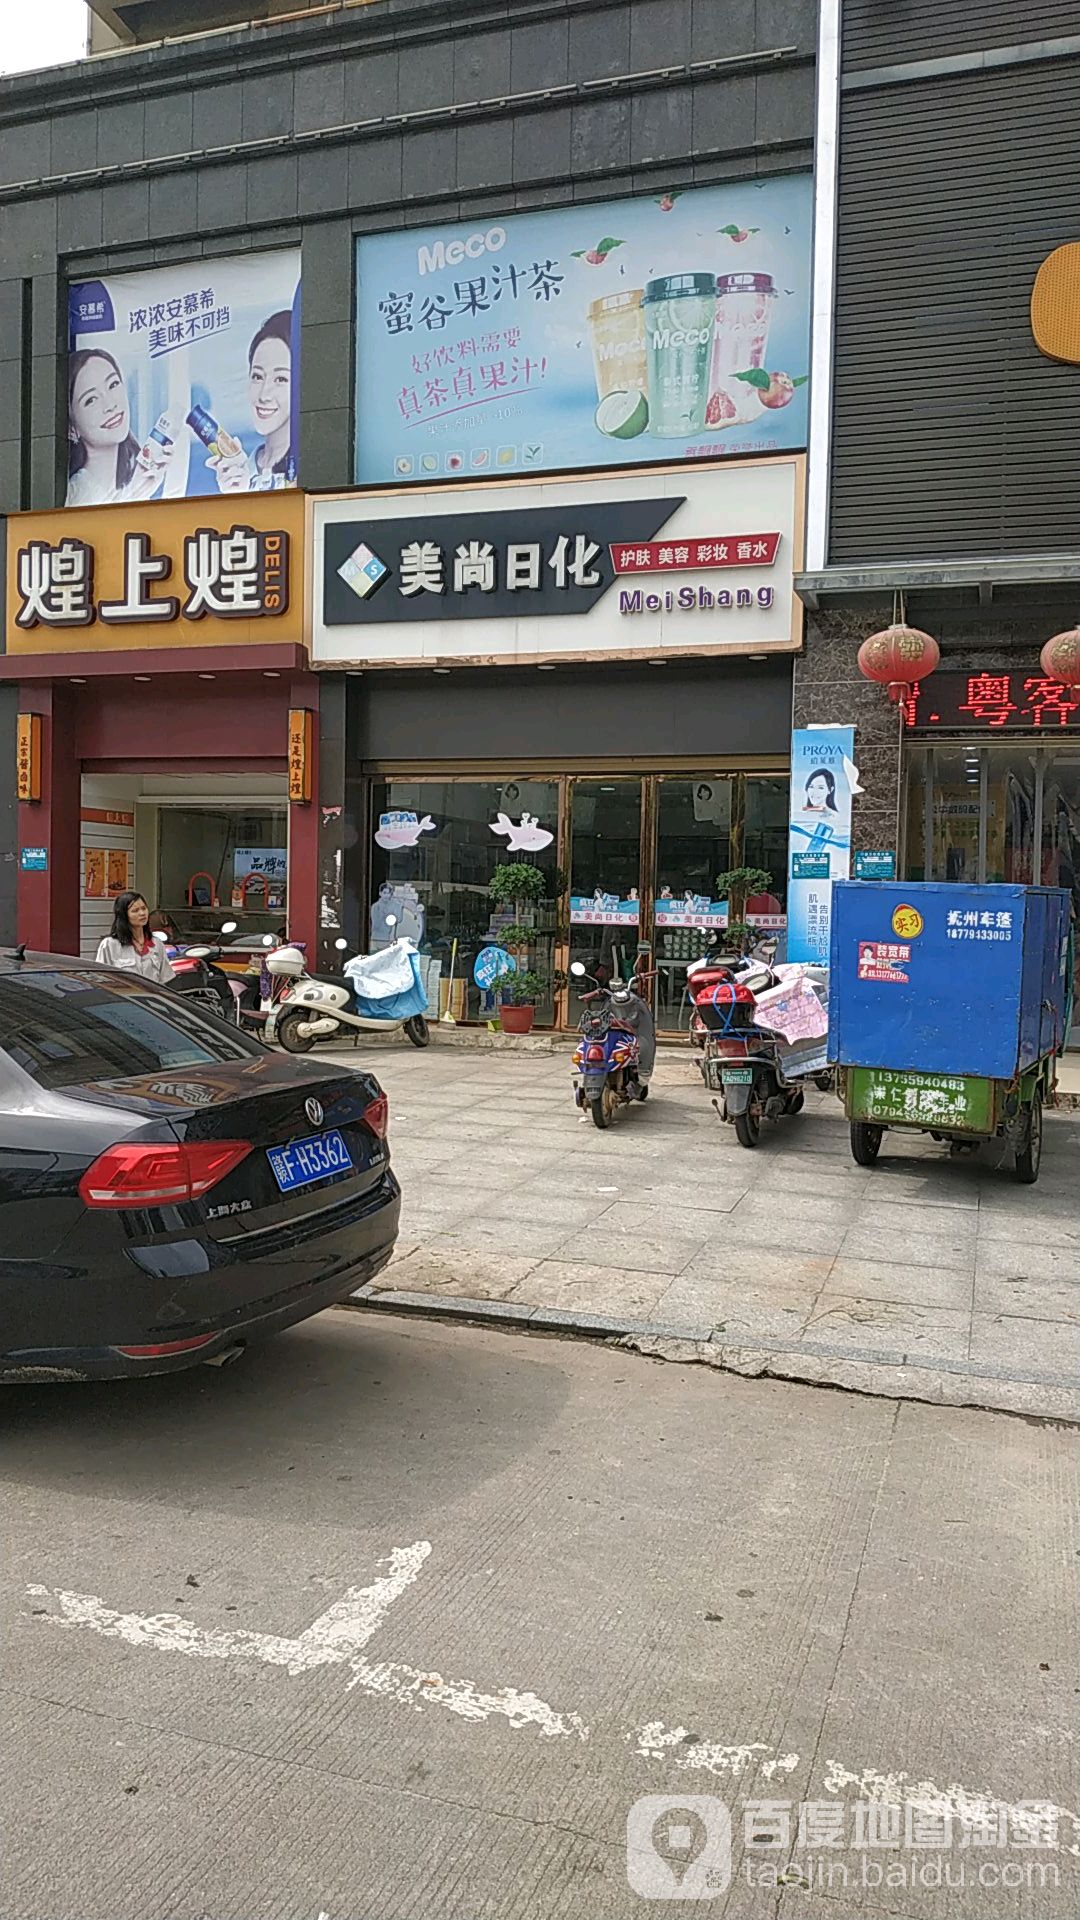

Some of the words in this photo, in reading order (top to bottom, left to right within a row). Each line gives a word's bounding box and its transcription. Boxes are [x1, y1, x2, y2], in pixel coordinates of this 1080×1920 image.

[417, 227, 507, 276] Meco
[129, 287, 215, 333] 浓浓安慕希
[378, 259, 564, 335] 蜜谷果汁茶
[149, 306, 230, 351] 美味不可挡
[412, 326, 521, 374] 好饮料需要
[398, 356, 547, 420] 真茶真果汁!
[19, 531, 261, 622] 煌上煌
[264, 536, 280, 608] DELIS
[400, 535, 600, 596] 美尚日化
[621, 550, 650, 567] 护肤
[658, 546, 689, 564] 美容
[697, 543, 728, 562] 彩妆
[736, 541, 768, 559] 香水
[619, 584, 774, 612] MeiShang
[895, 913, 920, 933] 实习
